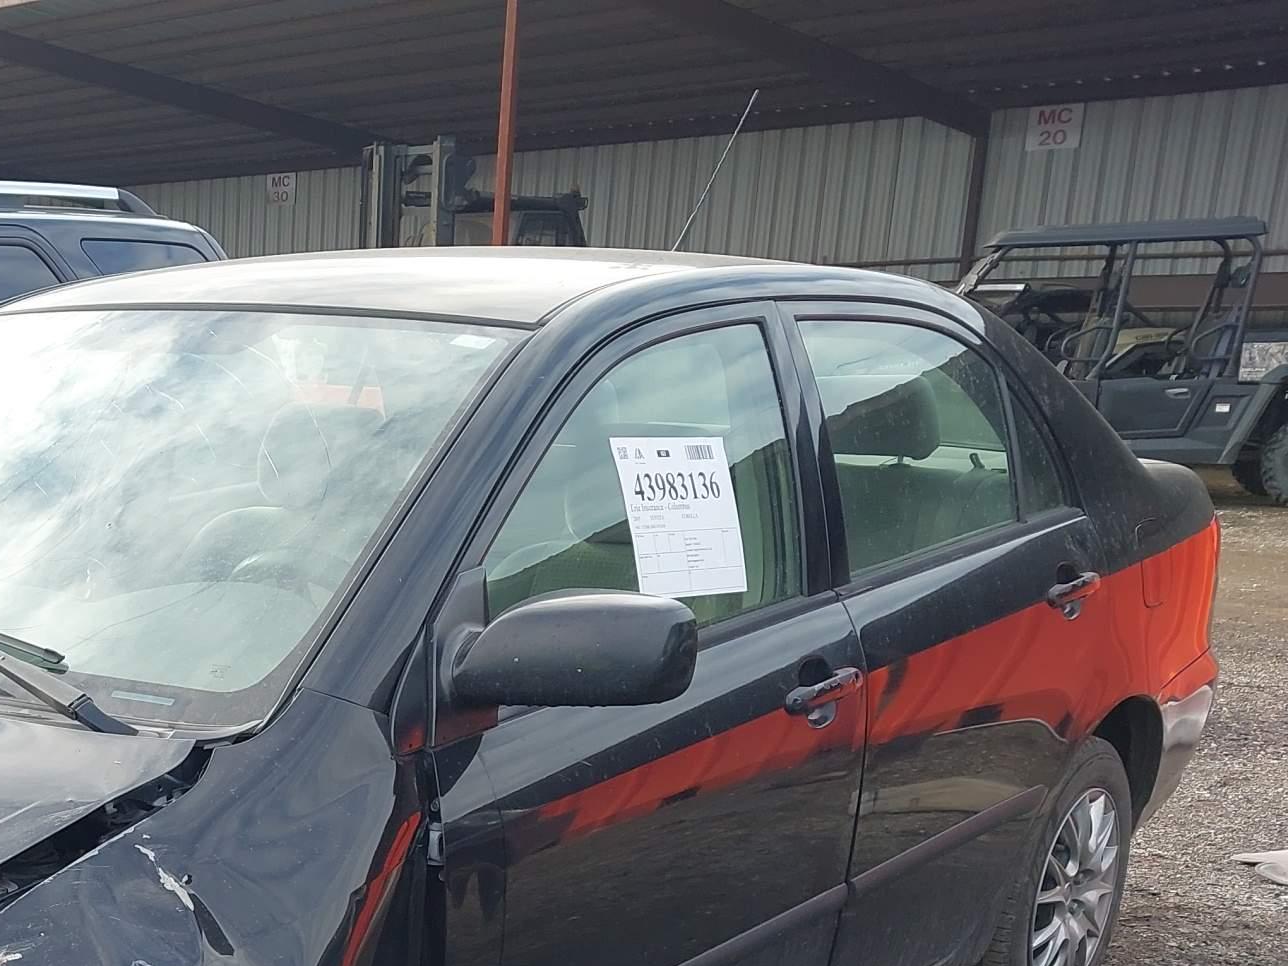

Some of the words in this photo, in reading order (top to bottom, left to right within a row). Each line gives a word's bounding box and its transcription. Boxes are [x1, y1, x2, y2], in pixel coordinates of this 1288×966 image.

[1038, 108, 1073, 125] MC
[1038, 129, 1067, 146] 20
[272, 175, 290, 187] MC
[273, 191, 289, 202] 30
[634, 471, 721, 501] 43983136
